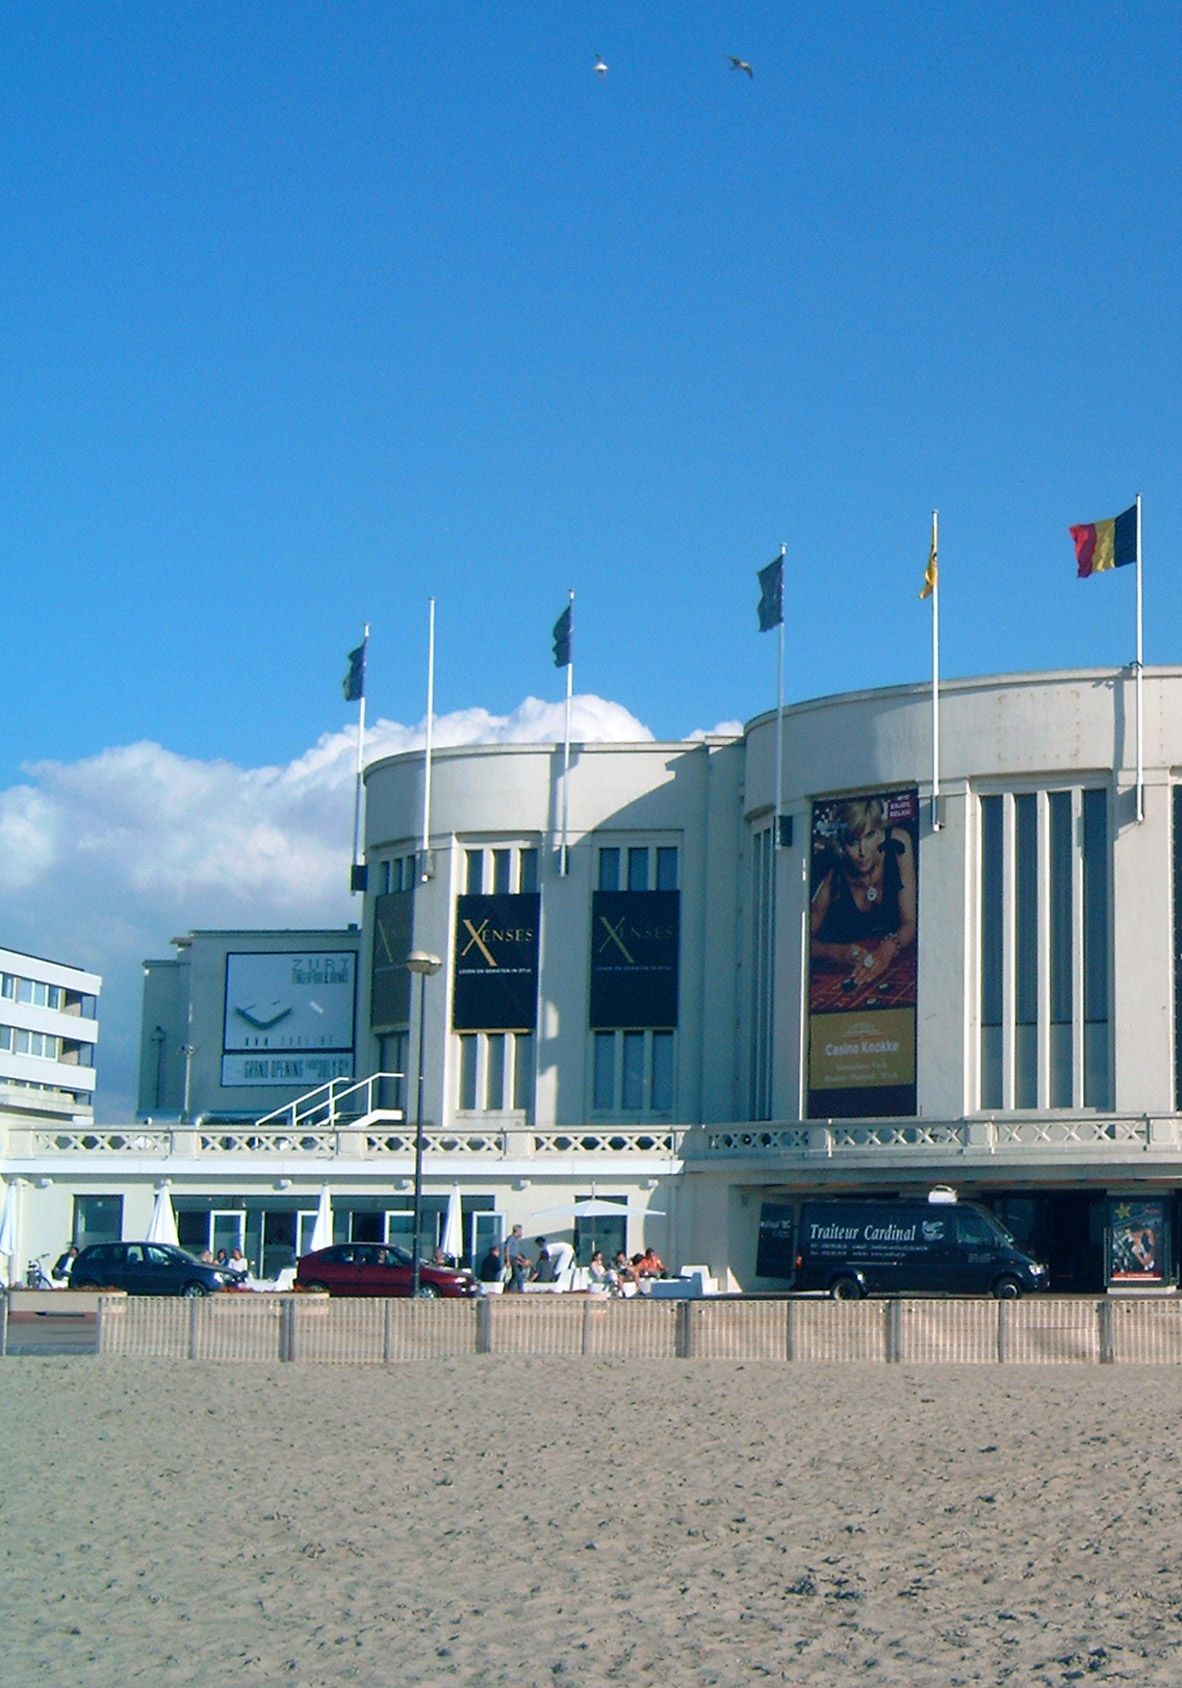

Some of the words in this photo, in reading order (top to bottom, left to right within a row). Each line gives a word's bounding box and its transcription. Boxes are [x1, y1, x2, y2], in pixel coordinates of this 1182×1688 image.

[461, 918, 534, 967] XENSES
[825, 1043, 860, 1057] Casino
[810, 1223, 859, 1241] Traiteur
[863, 1223, 917, 1242] Cardinal
